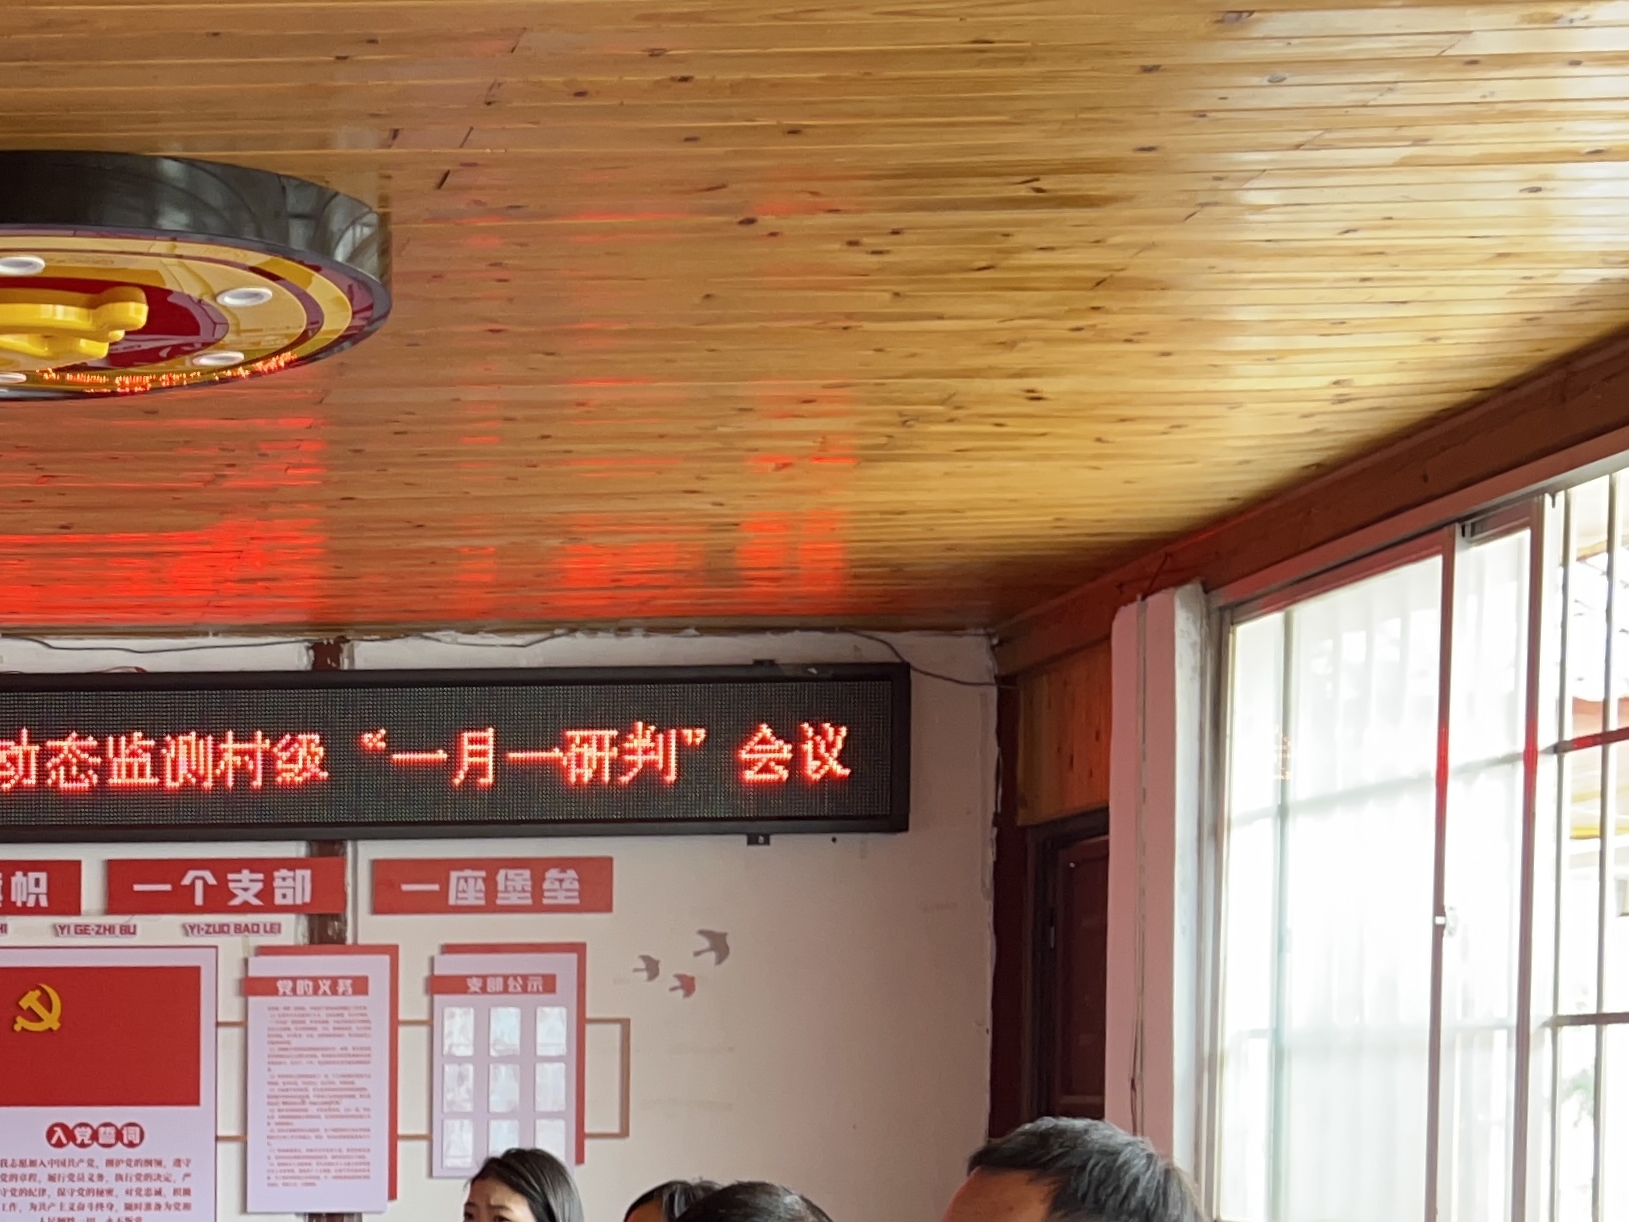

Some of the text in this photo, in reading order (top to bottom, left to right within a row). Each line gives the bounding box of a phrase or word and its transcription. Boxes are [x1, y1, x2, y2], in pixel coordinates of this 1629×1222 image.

[737, 722, 851, 784] 会议
[133, 868, 312, 906] 一个支部
[400, 868, 581, 906] 一座堡垒
[59, 923, 71, 936] YI
